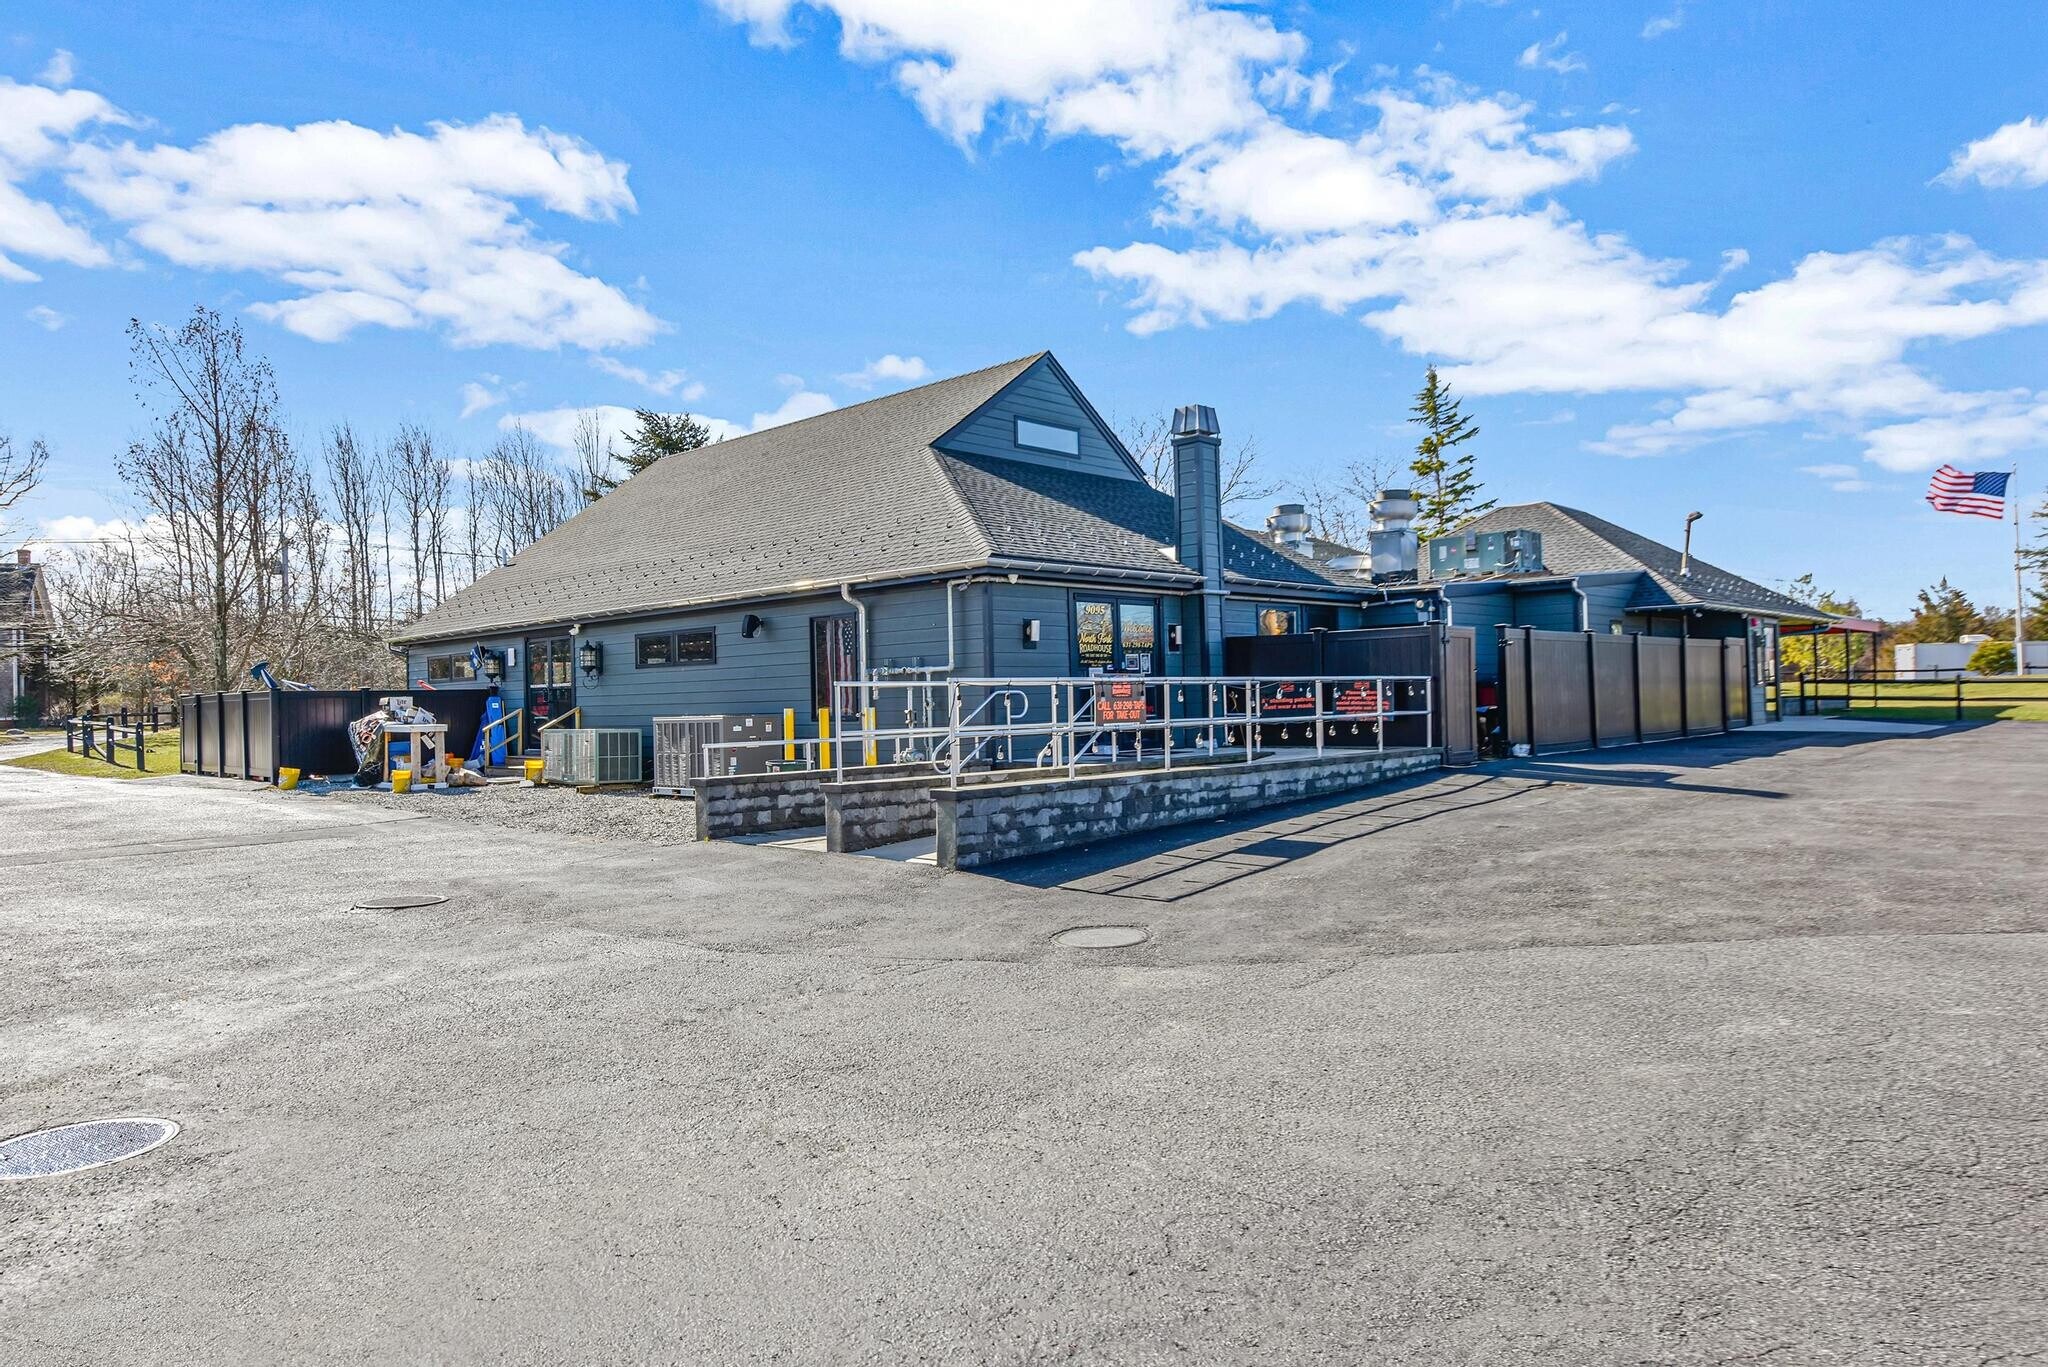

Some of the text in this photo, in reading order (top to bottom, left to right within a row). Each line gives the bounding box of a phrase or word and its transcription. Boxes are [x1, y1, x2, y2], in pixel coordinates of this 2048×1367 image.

[1085, 605, 1105, 615] 9095
[1079, 632, 1112, 644] North Fork
[1079, 644, 1112, 654] ROADHOUSE
[1097, 701, 1111, 710] CALL
[1103, 710, 1140, 720] FOR TAKE-OUT
